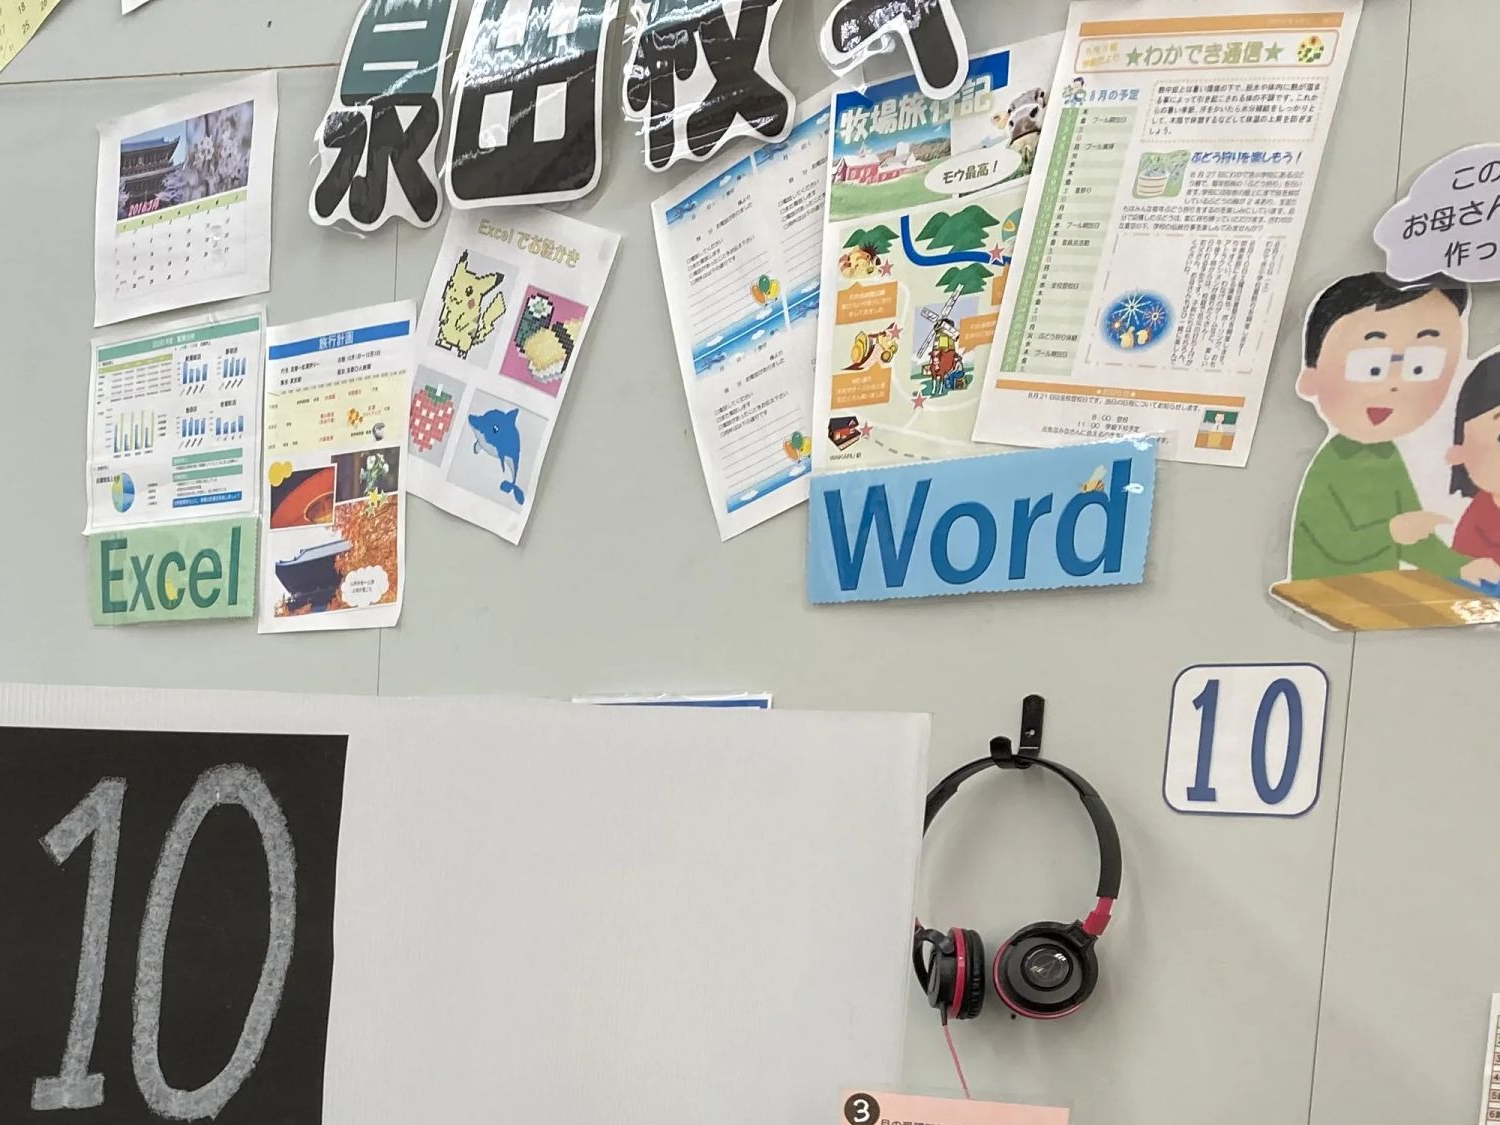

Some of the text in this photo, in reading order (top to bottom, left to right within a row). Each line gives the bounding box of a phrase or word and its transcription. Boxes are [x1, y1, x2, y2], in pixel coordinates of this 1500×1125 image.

[841, 75, 994, 144] 牧場旅行記
[943, 160, 998, 184] モウ最高！
[478, 219, 514, 244] Excel
[319, 331, 354, 350] 旅行計画
[823, 458, 1133, 591] Word
[101, 525, 241, 614] Excel
[1186, 678, 1303, 805] 10
[30, 762, 298, 1122] 10
[853, 1099, 870, 1123] 3
